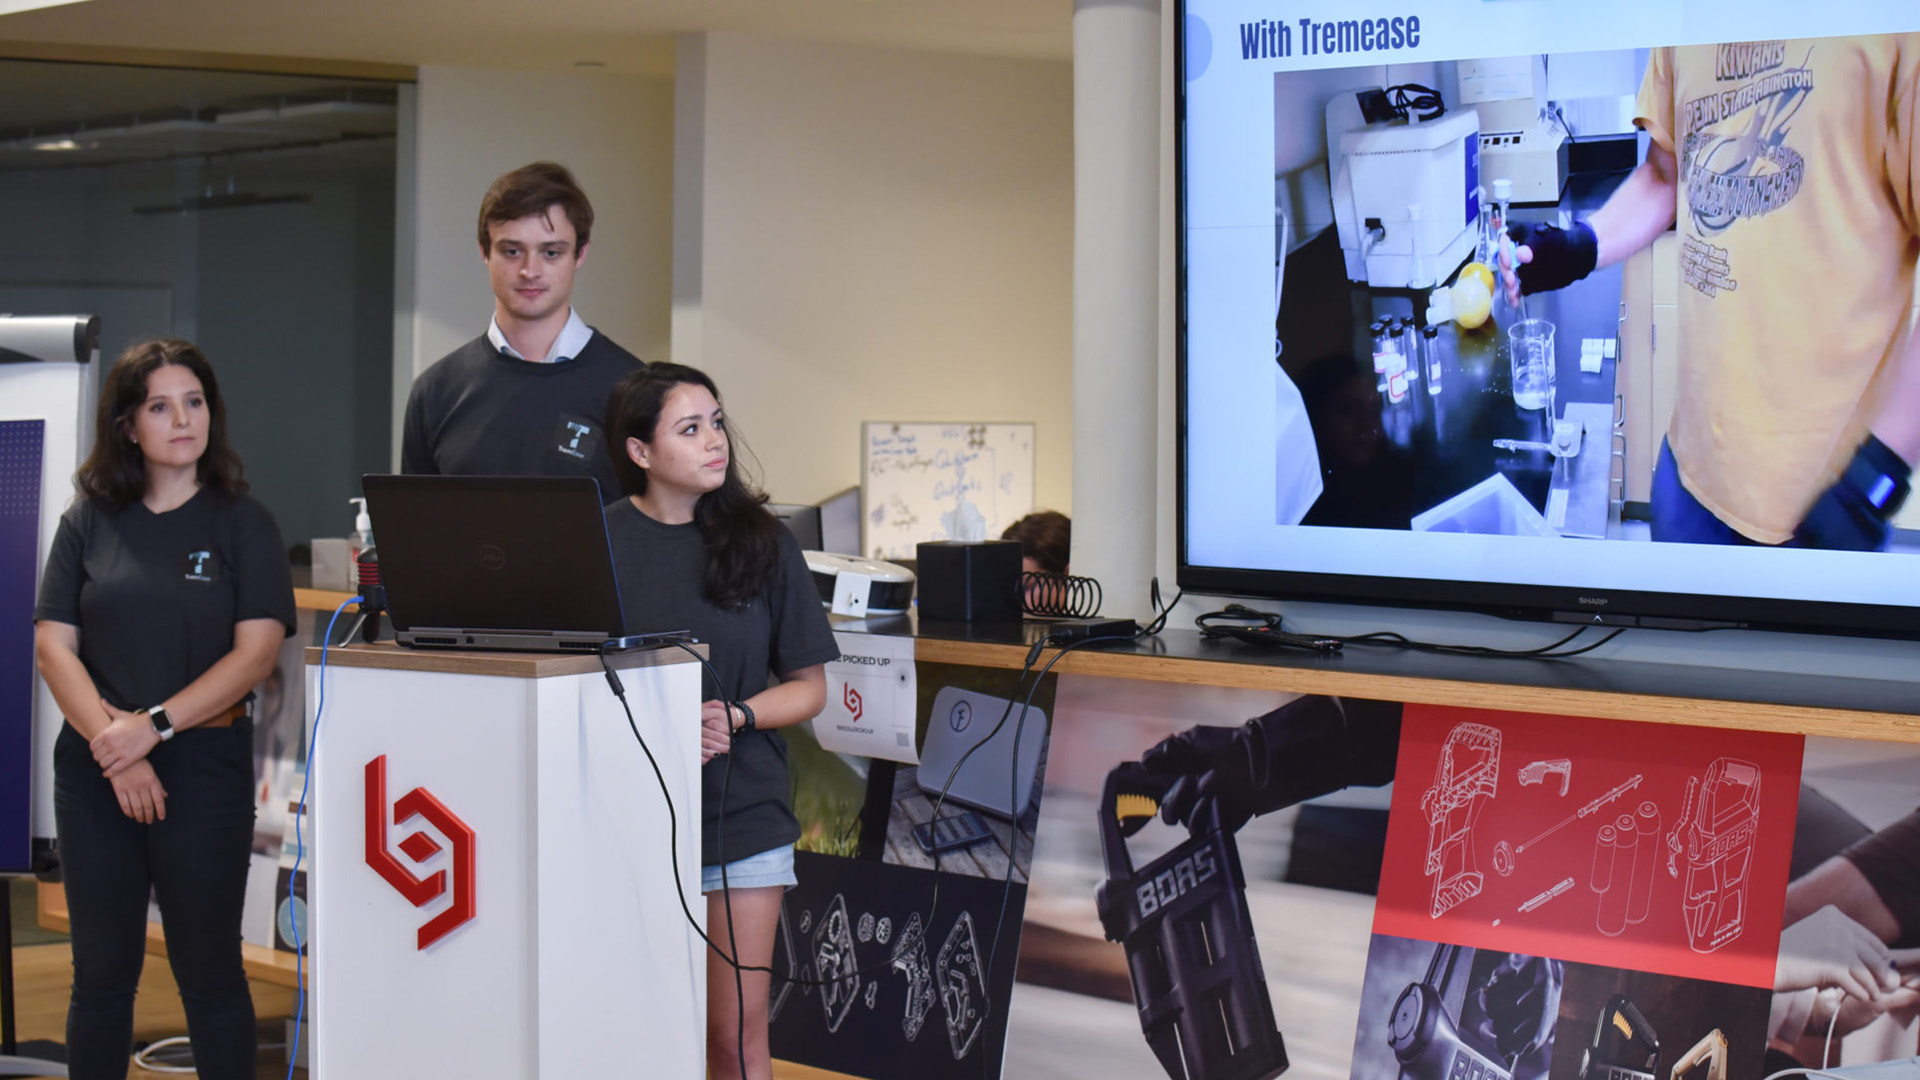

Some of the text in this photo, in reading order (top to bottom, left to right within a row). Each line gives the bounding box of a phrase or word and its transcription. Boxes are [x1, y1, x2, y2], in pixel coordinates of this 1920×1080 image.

[1240, 15, 1420, 60] With Tremease
[1716, 41, 1785, 81] KIWANIS
[1686, 93, 1719, 135] PENN
[1720, 82, 1755, 120] STATE
[1579, 597, 1608, 605] SHARP
[843, 655, 877, 666] PICKED
[877, 658, 891, 667] UP
